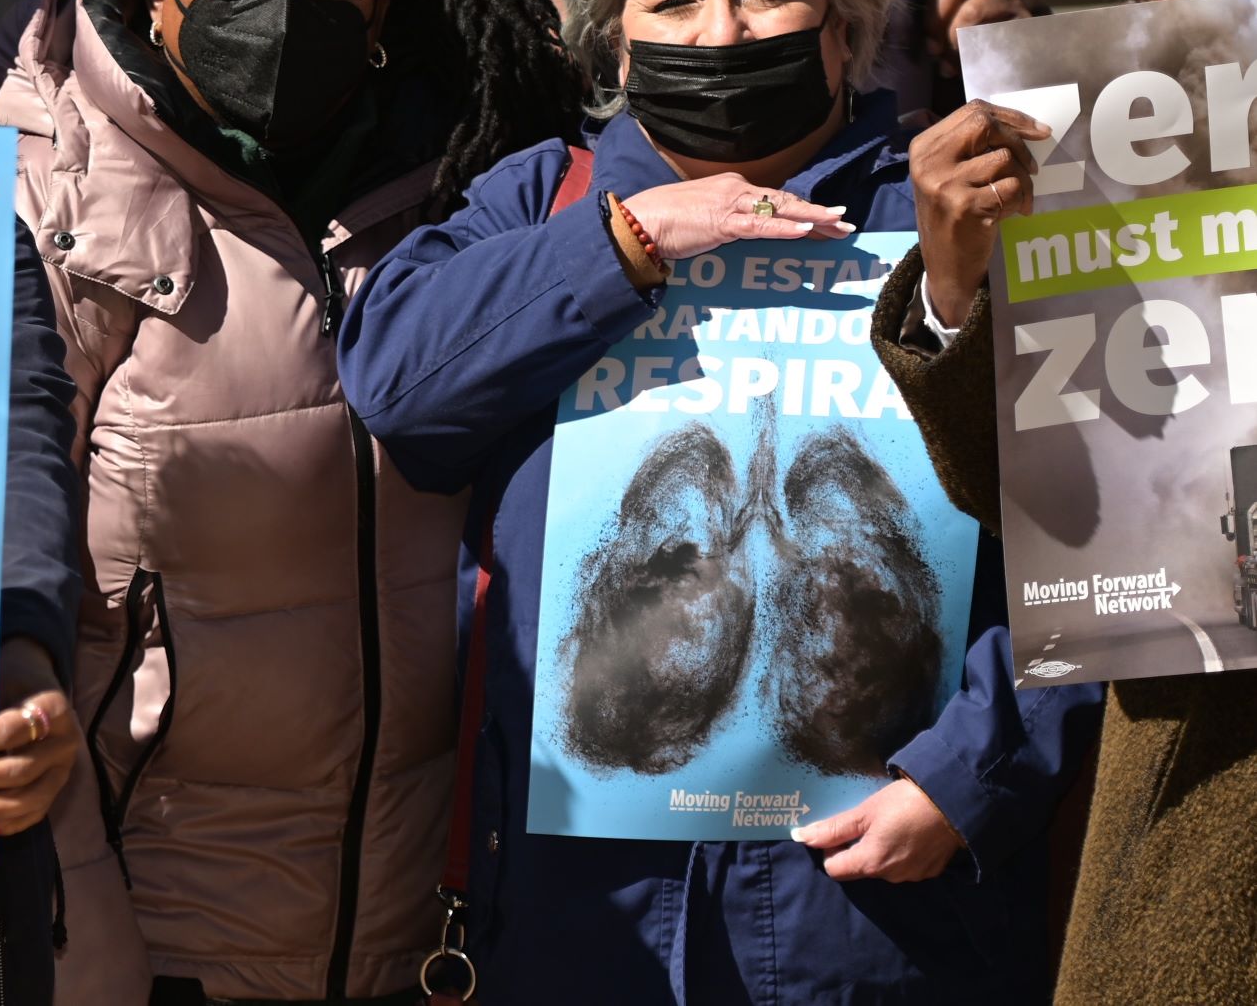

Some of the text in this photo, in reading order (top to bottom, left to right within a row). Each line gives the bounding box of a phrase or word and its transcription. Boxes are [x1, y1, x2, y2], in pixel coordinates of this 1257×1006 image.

[990, 60, 1257, 197] zer
[1015, 211, 1183, 283] must
[666, 255, 726, 289] LO
[634, 305, 872, 344] RATANDO
[575, 356, 915, 420] RESPIRA
[1023, 567, 1167, 601] Moving Forward
[1095, 592, 1172, 615] Network
[670, 789, 800, 811] Moving Forward
[733, 808, 799, 827] Network
